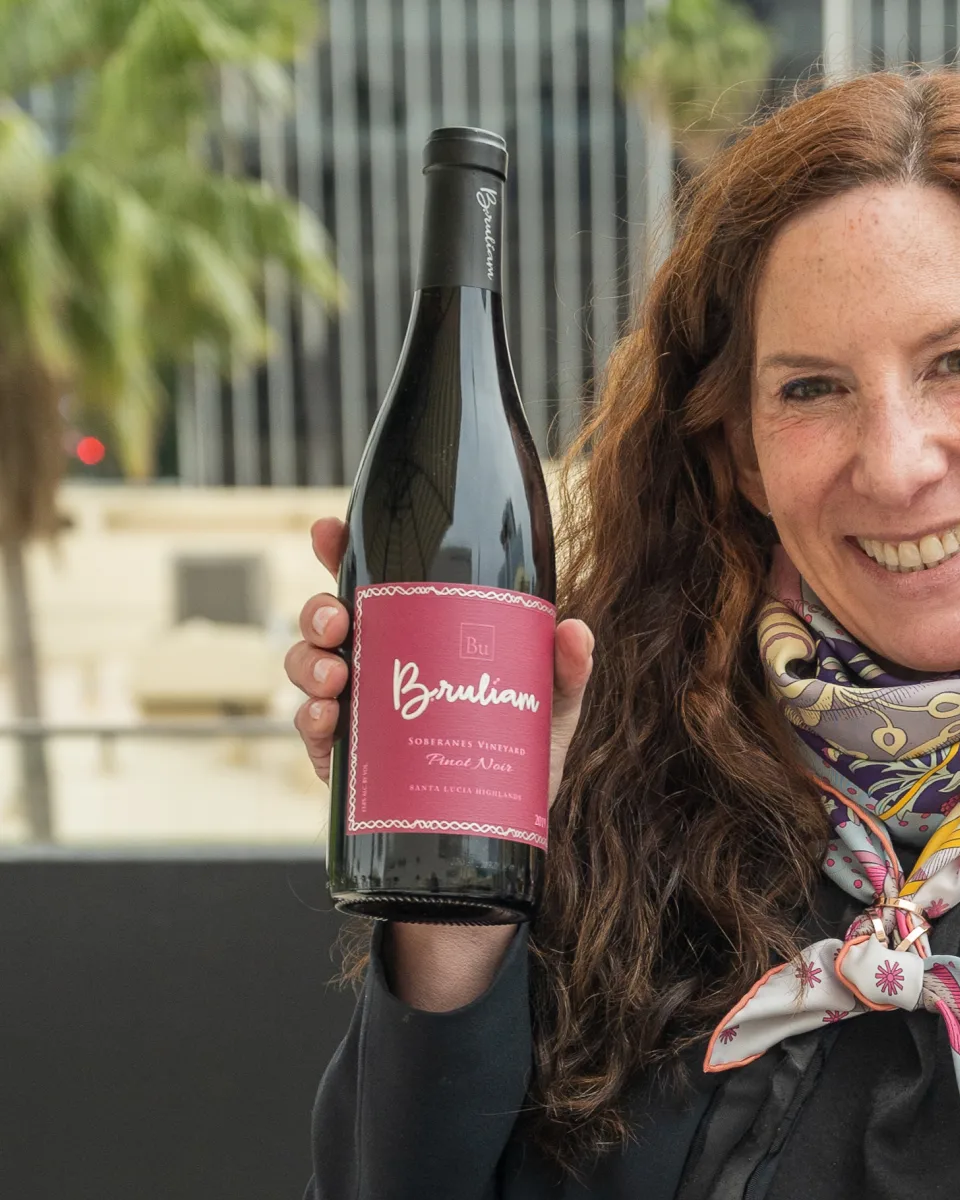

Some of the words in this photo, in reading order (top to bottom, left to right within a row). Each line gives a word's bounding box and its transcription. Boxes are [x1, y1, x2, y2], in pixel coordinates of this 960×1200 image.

[466, 636, 489, 656] Bu
[393, 658, 540, 721] Bruliam
[407, 737, 473, 749] SOBERANES
[477, 740, 526, 756] VINEYARD
[425, 752, 471, 767] Pinot
[470, 756, 515, 773] Noir
[409, 783, 441, 793] SANTA
[443, 784, 473, 796] LUCIA
[475, 787, 522, 801] HIGHLANDS
